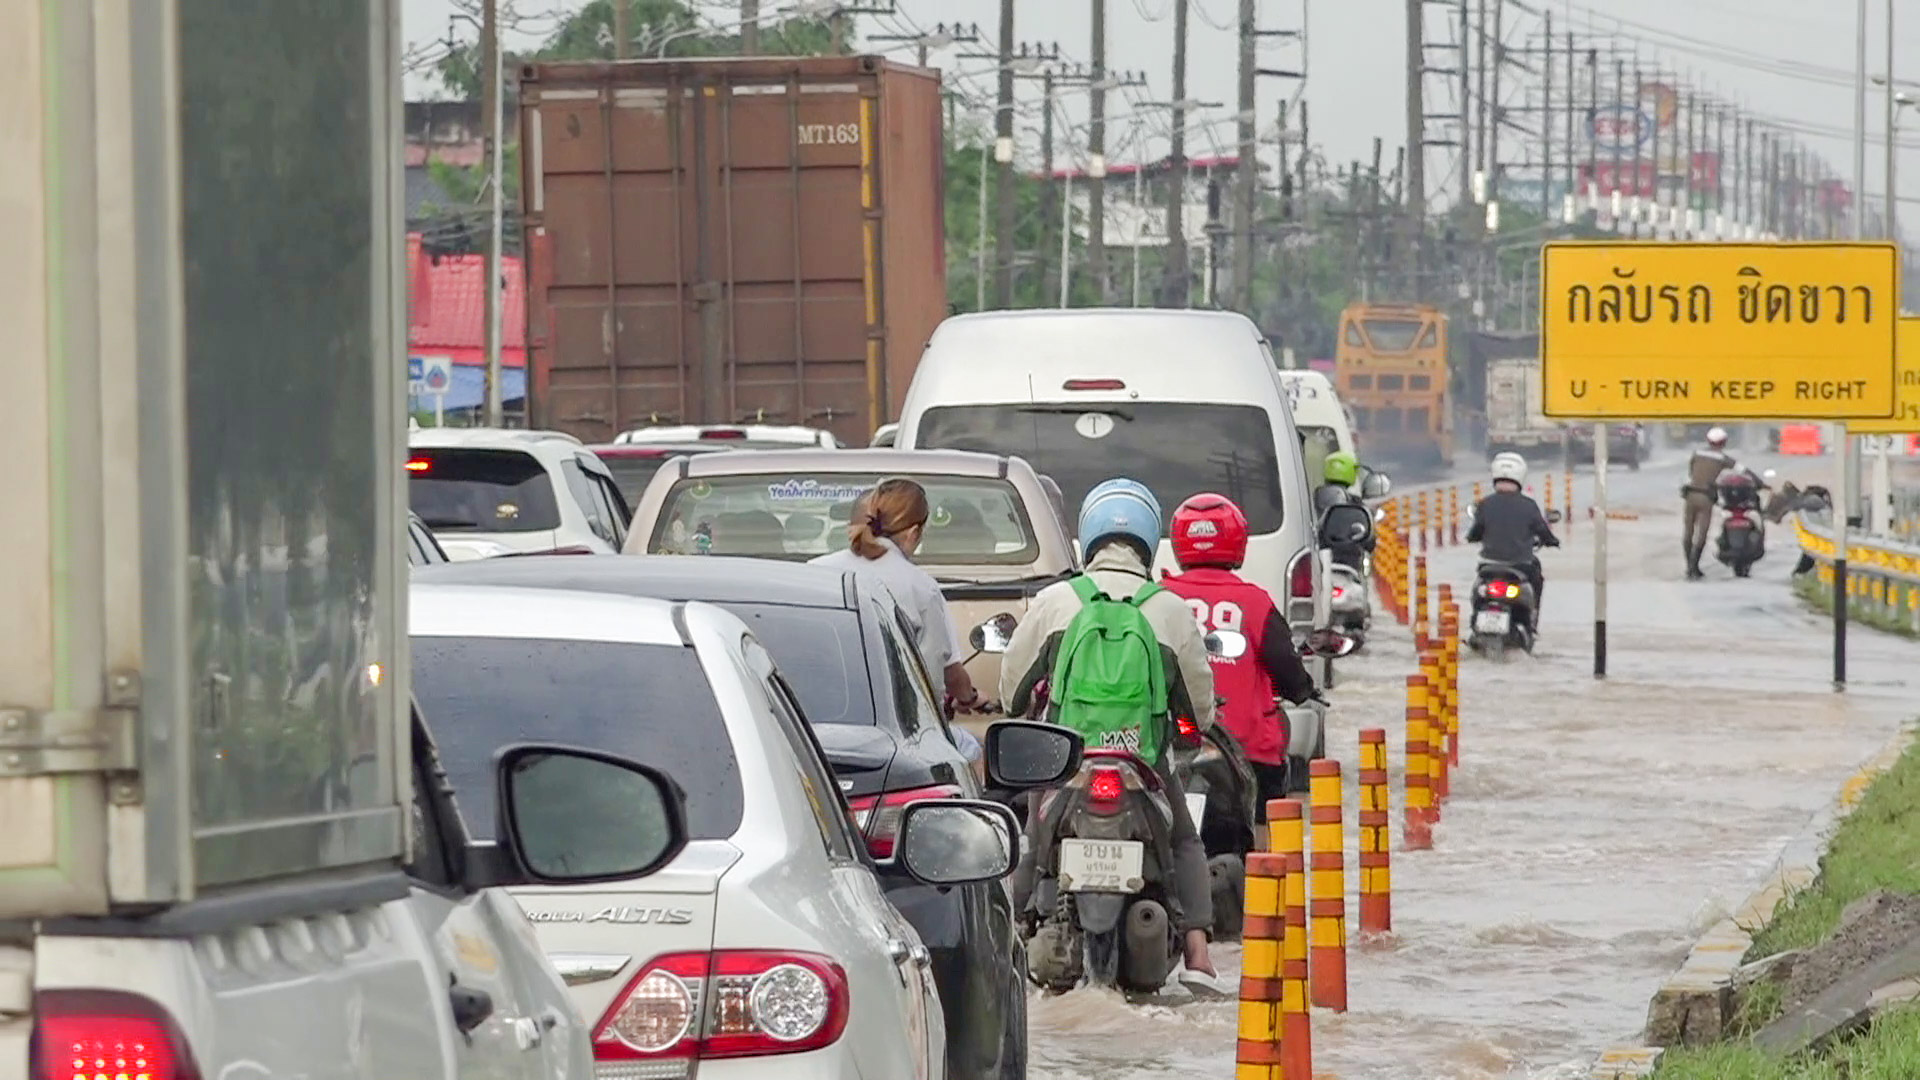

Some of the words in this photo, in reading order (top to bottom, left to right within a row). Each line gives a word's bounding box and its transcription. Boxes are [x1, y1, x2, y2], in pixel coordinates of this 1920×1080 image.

[798, 123, 859, 144] MT163
[1567, 266, 1711, 323] กลับรถ
[1736, 266, 1872, 323] ชิดขวา
[1570, 380, 1586, 398] U
[1620, 380, 1689, 399] TURN
[1711, 380, 1775, 399] KEEP
[1795, 380, 1867, 399] RIGHT
[587, 907, 693, 924] ALTIS
